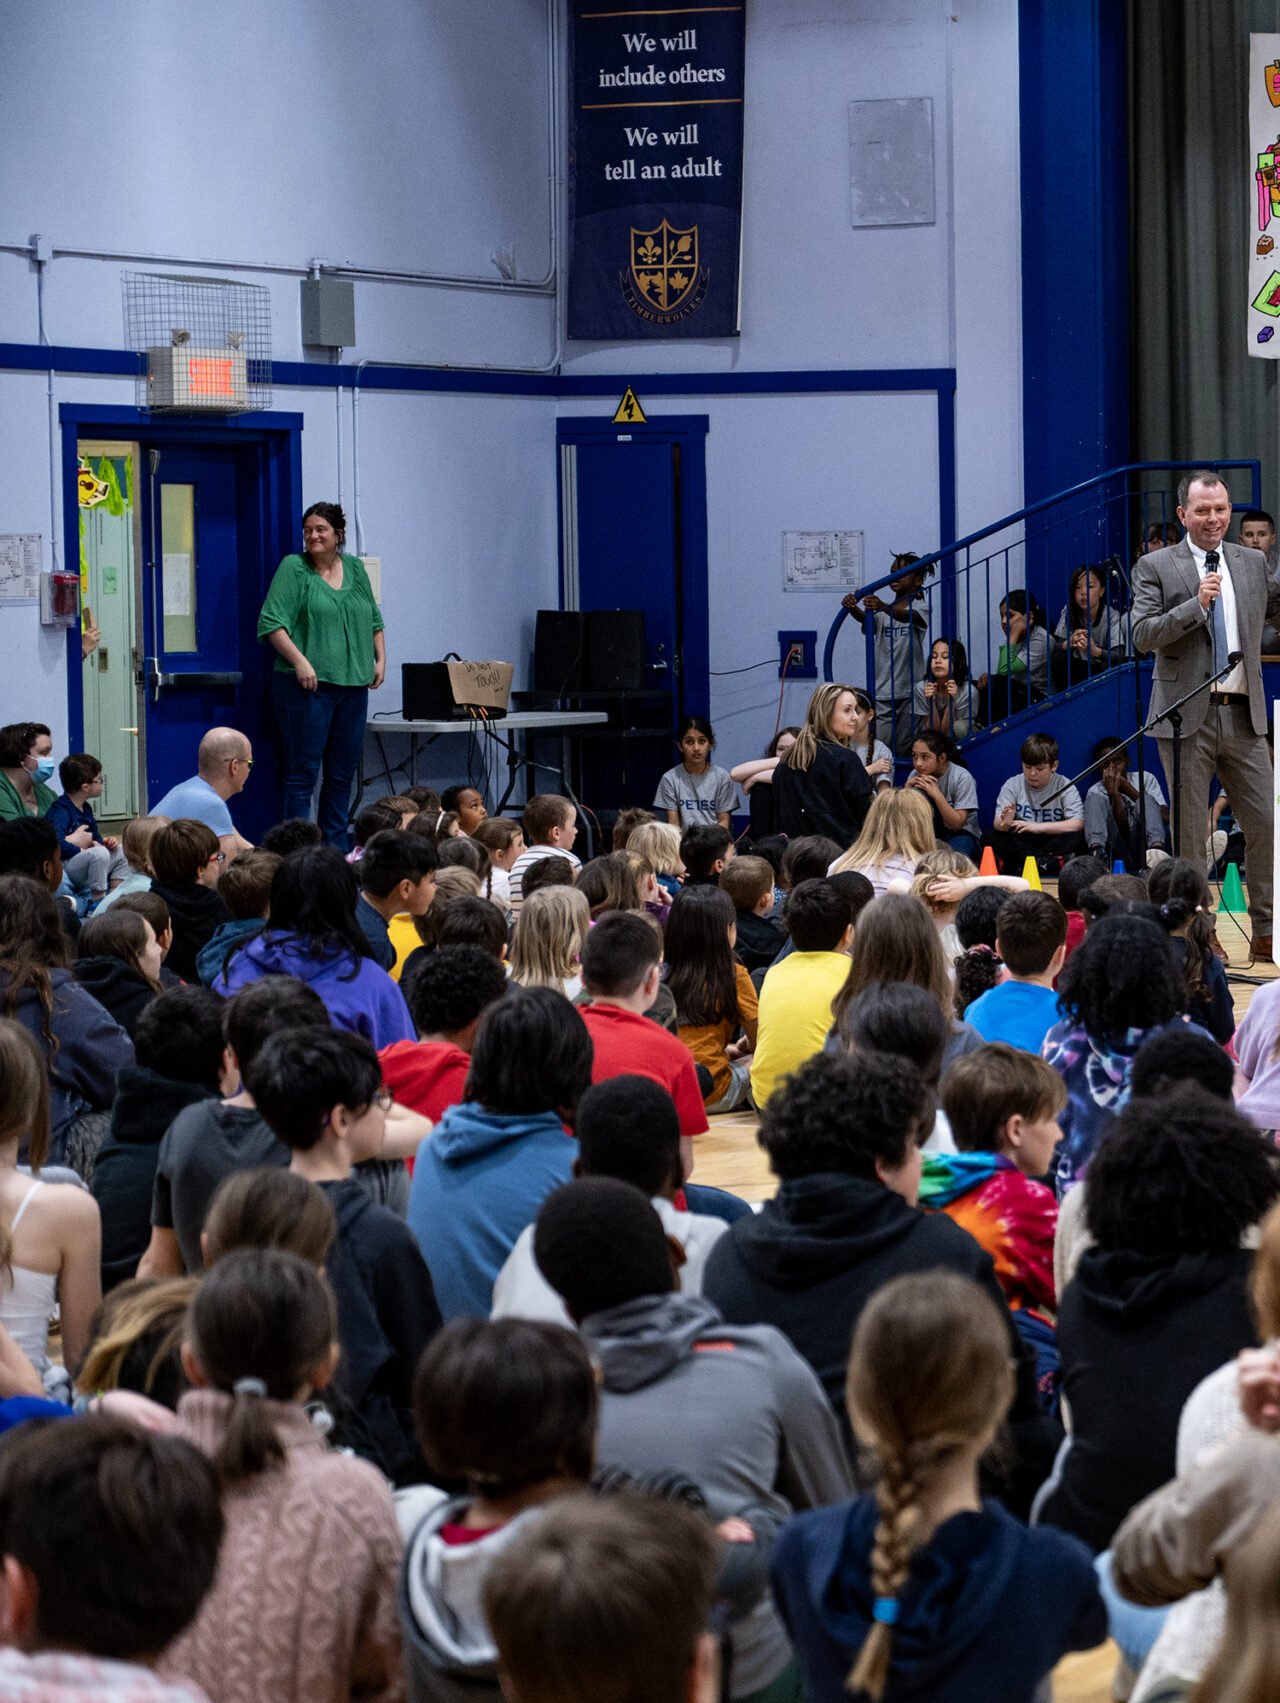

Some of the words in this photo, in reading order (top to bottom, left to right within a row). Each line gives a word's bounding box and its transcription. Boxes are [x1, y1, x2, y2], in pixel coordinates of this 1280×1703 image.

[622, 32, 656, 53] We
[660, 28, 698, 51] will
[599, 64, 666, 88] include
[668, 62, 726, 85] others
[623, 126, 658, 147] We
[661, 123, 699, 146] will
[604, 159, 637, 181] tell
[640, 165, 667, 180] an
[670, 156, 723, 179] adult
[627, 295, 702, 324] TIMBERWOLVES
[1015, 803, 1065, 822] PETES
